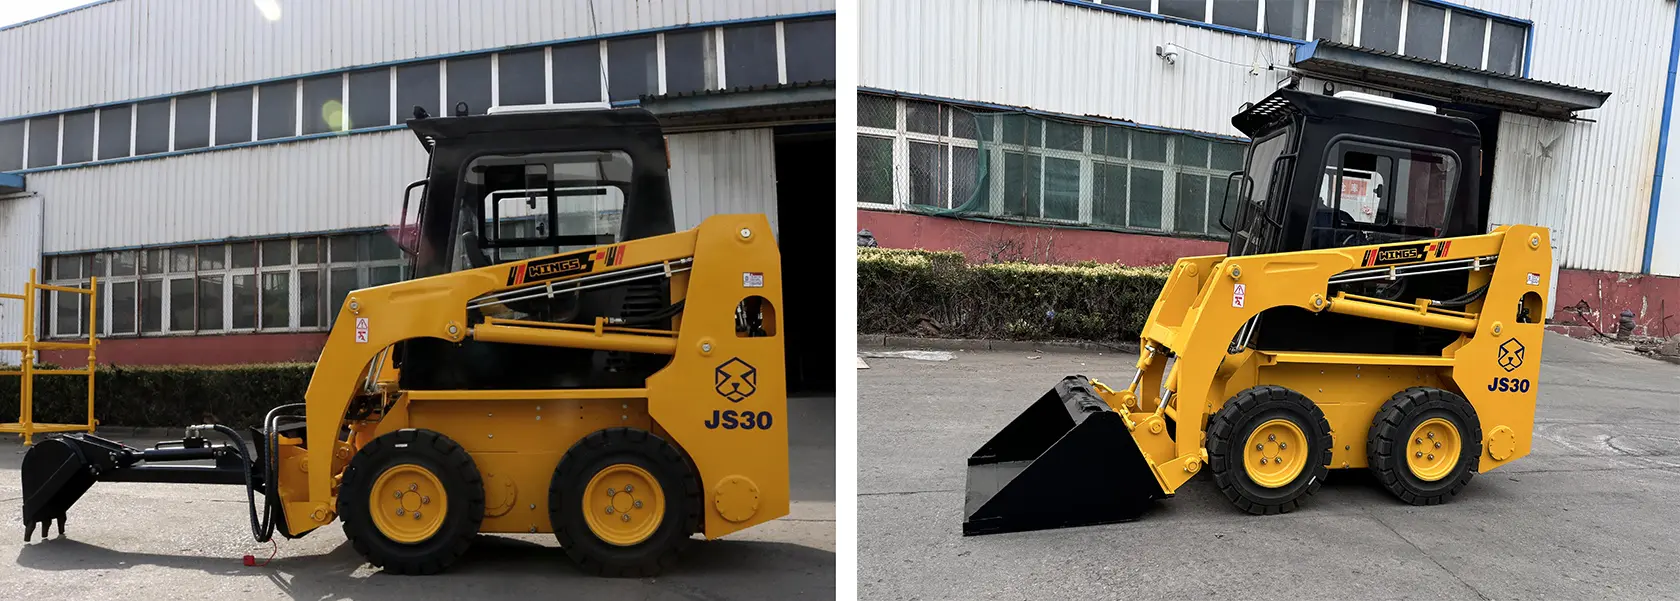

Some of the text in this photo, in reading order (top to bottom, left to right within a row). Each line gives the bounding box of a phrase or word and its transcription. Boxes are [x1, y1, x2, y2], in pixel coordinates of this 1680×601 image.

[1379, 248, 1418, 261] WINGS
[528, 258, 581, 277] WINGS
[1487, 377, 1530, 393] JS30
[704, 410, 773, 430] JS30
